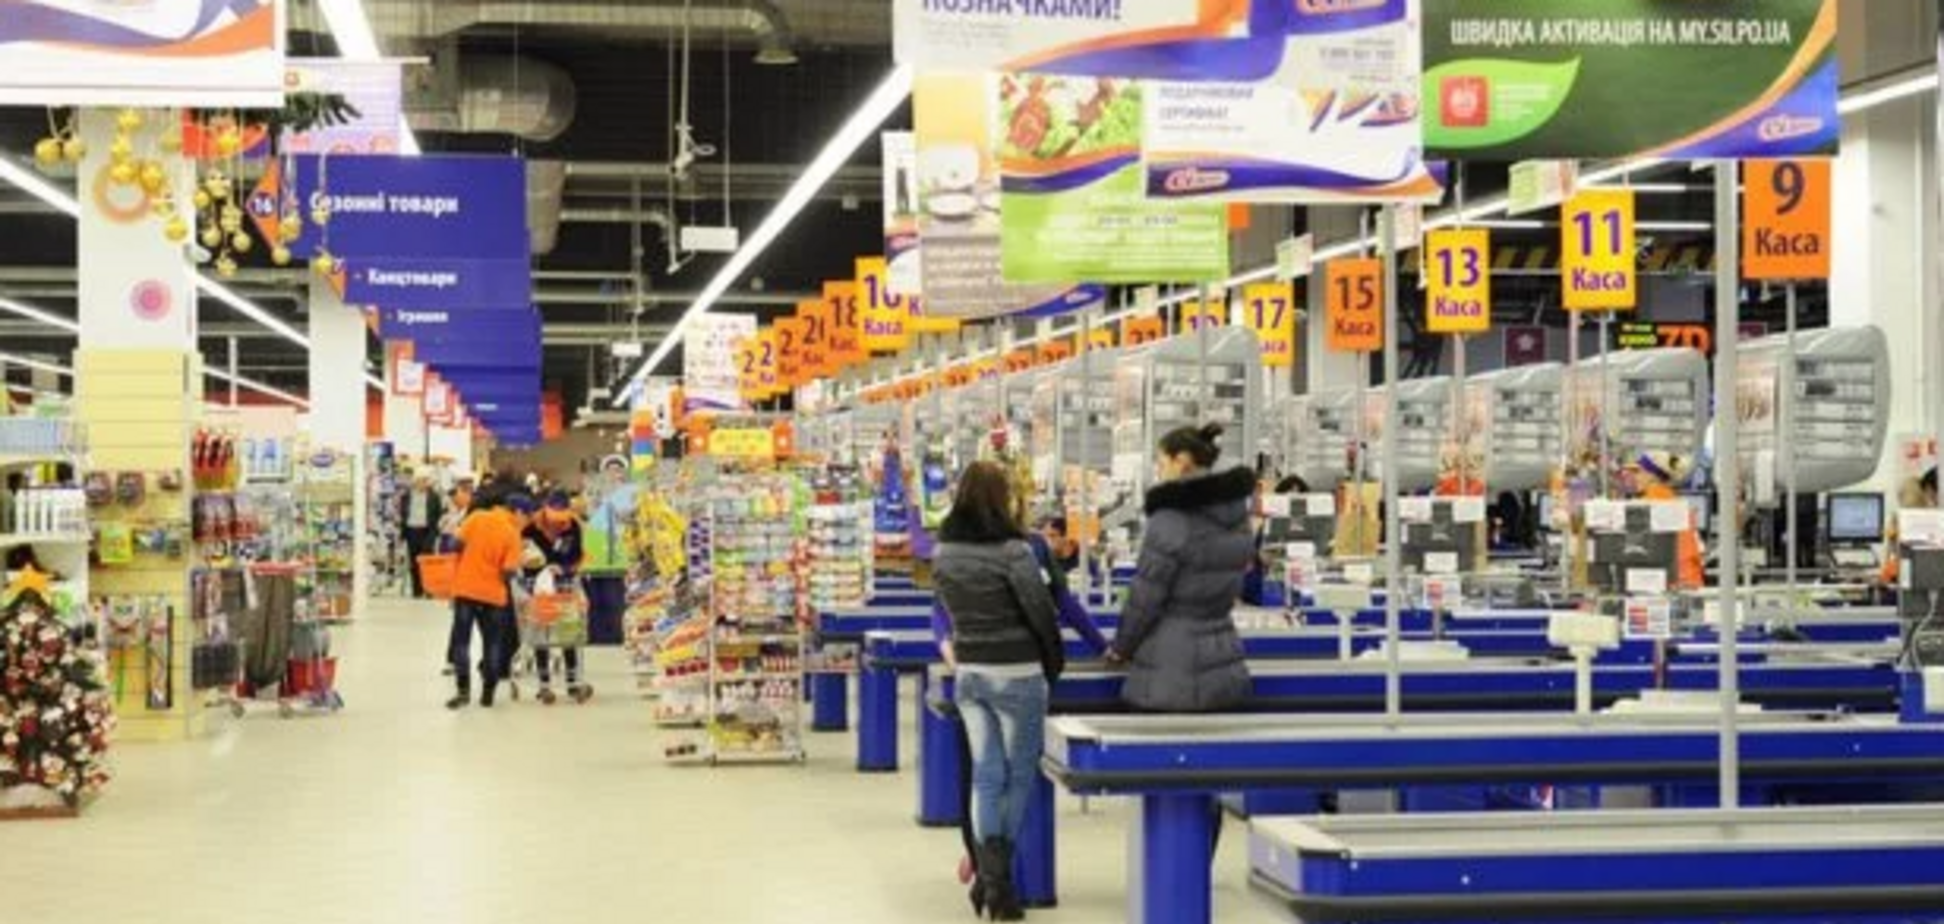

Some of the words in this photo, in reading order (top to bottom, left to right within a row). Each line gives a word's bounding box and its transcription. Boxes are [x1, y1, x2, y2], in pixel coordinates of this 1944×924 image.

[1451, 19, 1535, 47] ШВИДКА
[1540, 19, 1645, 47] АКТИВАЦІЯ
[1650, 20, 1675, 44] НА
[1679, 20, 1790, 44] MY.SILPO.UA
[1772, 160, 1804, 215] 9
[254, 195, 272, 212] 16
[388, 198, 459, 218] товари
[1573, 211, 1621, 255] 11
[1755, 227, 1819, 256] Каса
[1436, 248, 1480, 287] 13
[1572, 268, 1626, 290] Каса
[1335, 276, 1374, 310] 15
[1252, 298, 1287, 328] 17
[1435, 297, 1481, 316] Каса
[864, 318, 902, 336] Каса
[1335, 316, 1375, 336] Каса
[1262, 341, 1287, 354] аса
